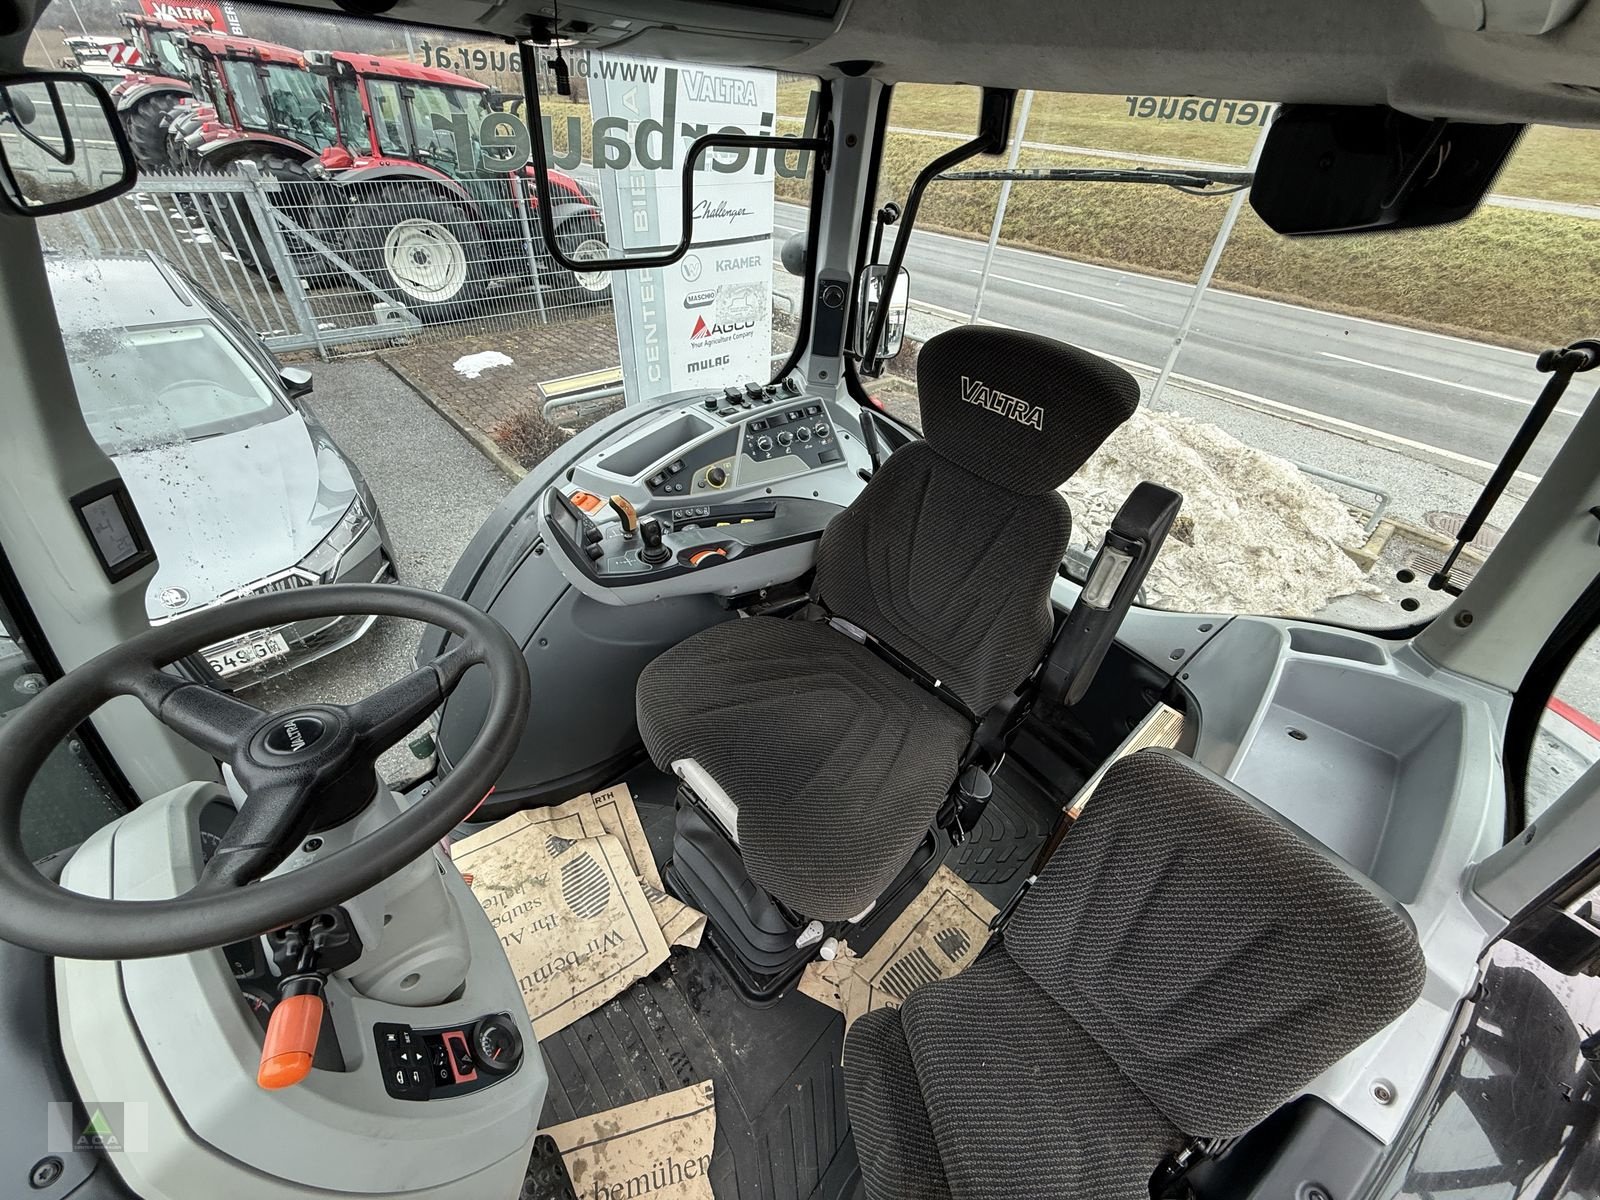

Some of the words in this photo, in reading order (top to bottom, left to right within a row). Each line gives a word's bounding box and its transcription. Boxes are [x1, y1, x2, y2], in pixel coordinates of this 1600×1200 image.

[152, 2, 216, 22] VALTRA
[681, 69, 758, 107] VALTRA
[692, 199, 755, 224] Challenger
[716, 255, 762, 272] KRAMER
[688, 292, 715, 303] MASCHIO
[704, 335, 732, 347] Agriculture
[732, 330, 754, 341] Company
[687, 354, 730, 374] MULAG
[961, 375, 1045, 432] VALTRA
[283, 719, 306, 753] VALTRA
[595, 791, 614, 804] RTH
[481, 880, 526, 910] halte
[490, 896, 542, 929] saube
[530, 913, 560, 934] Ihr
[500, 926, 525, 947] Au
[586, 929, 625, 956] Wir
[519, 950, 581, 995] bemü
